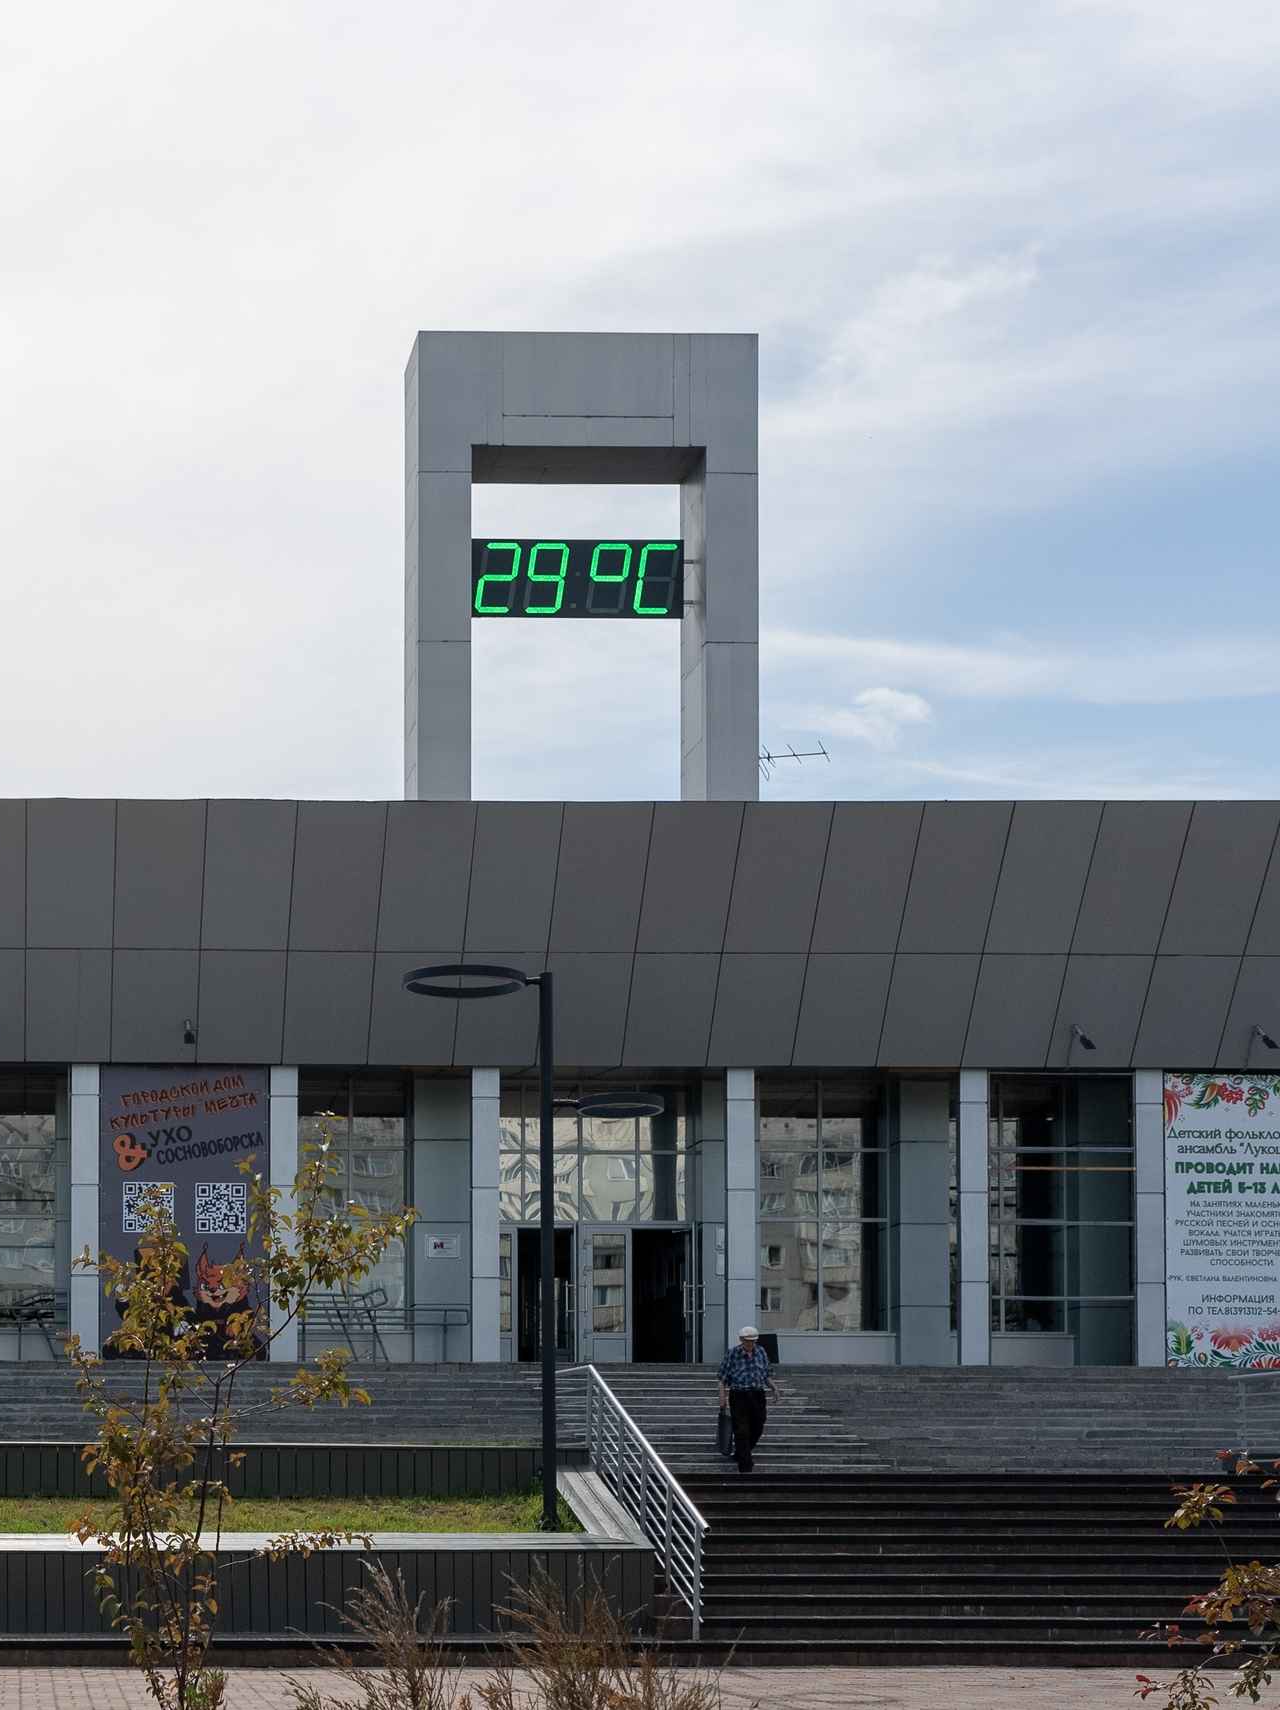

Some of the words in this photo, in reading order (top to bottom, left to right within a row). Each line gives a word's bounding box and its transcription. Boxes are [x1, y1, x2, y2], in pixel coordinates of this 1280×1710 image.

[474, 542, 570, 614] 29
[213, 1073, 245, 1091] ДОМ
[110, 1104, 196, 1130] КУЛЬТУРЫ
[147, 1125, 193, 1148] УХО
[1167, 1127, 1222, 1139] Детский
[156, 1131, 264, 1165] СОСНОВОБОРСКА
[1177, 1142, 1237, 1154] ансамбль
[1175, 1162, 1254, 1175] ПРОВОДИТ
[1187, 1179, 1232, 1194] ДЕТЕЙ
[1201, 1294, 1275, 1304] ИНФОРМАЦИЯ
[1188, 1306, 1203, 1315] ПО
